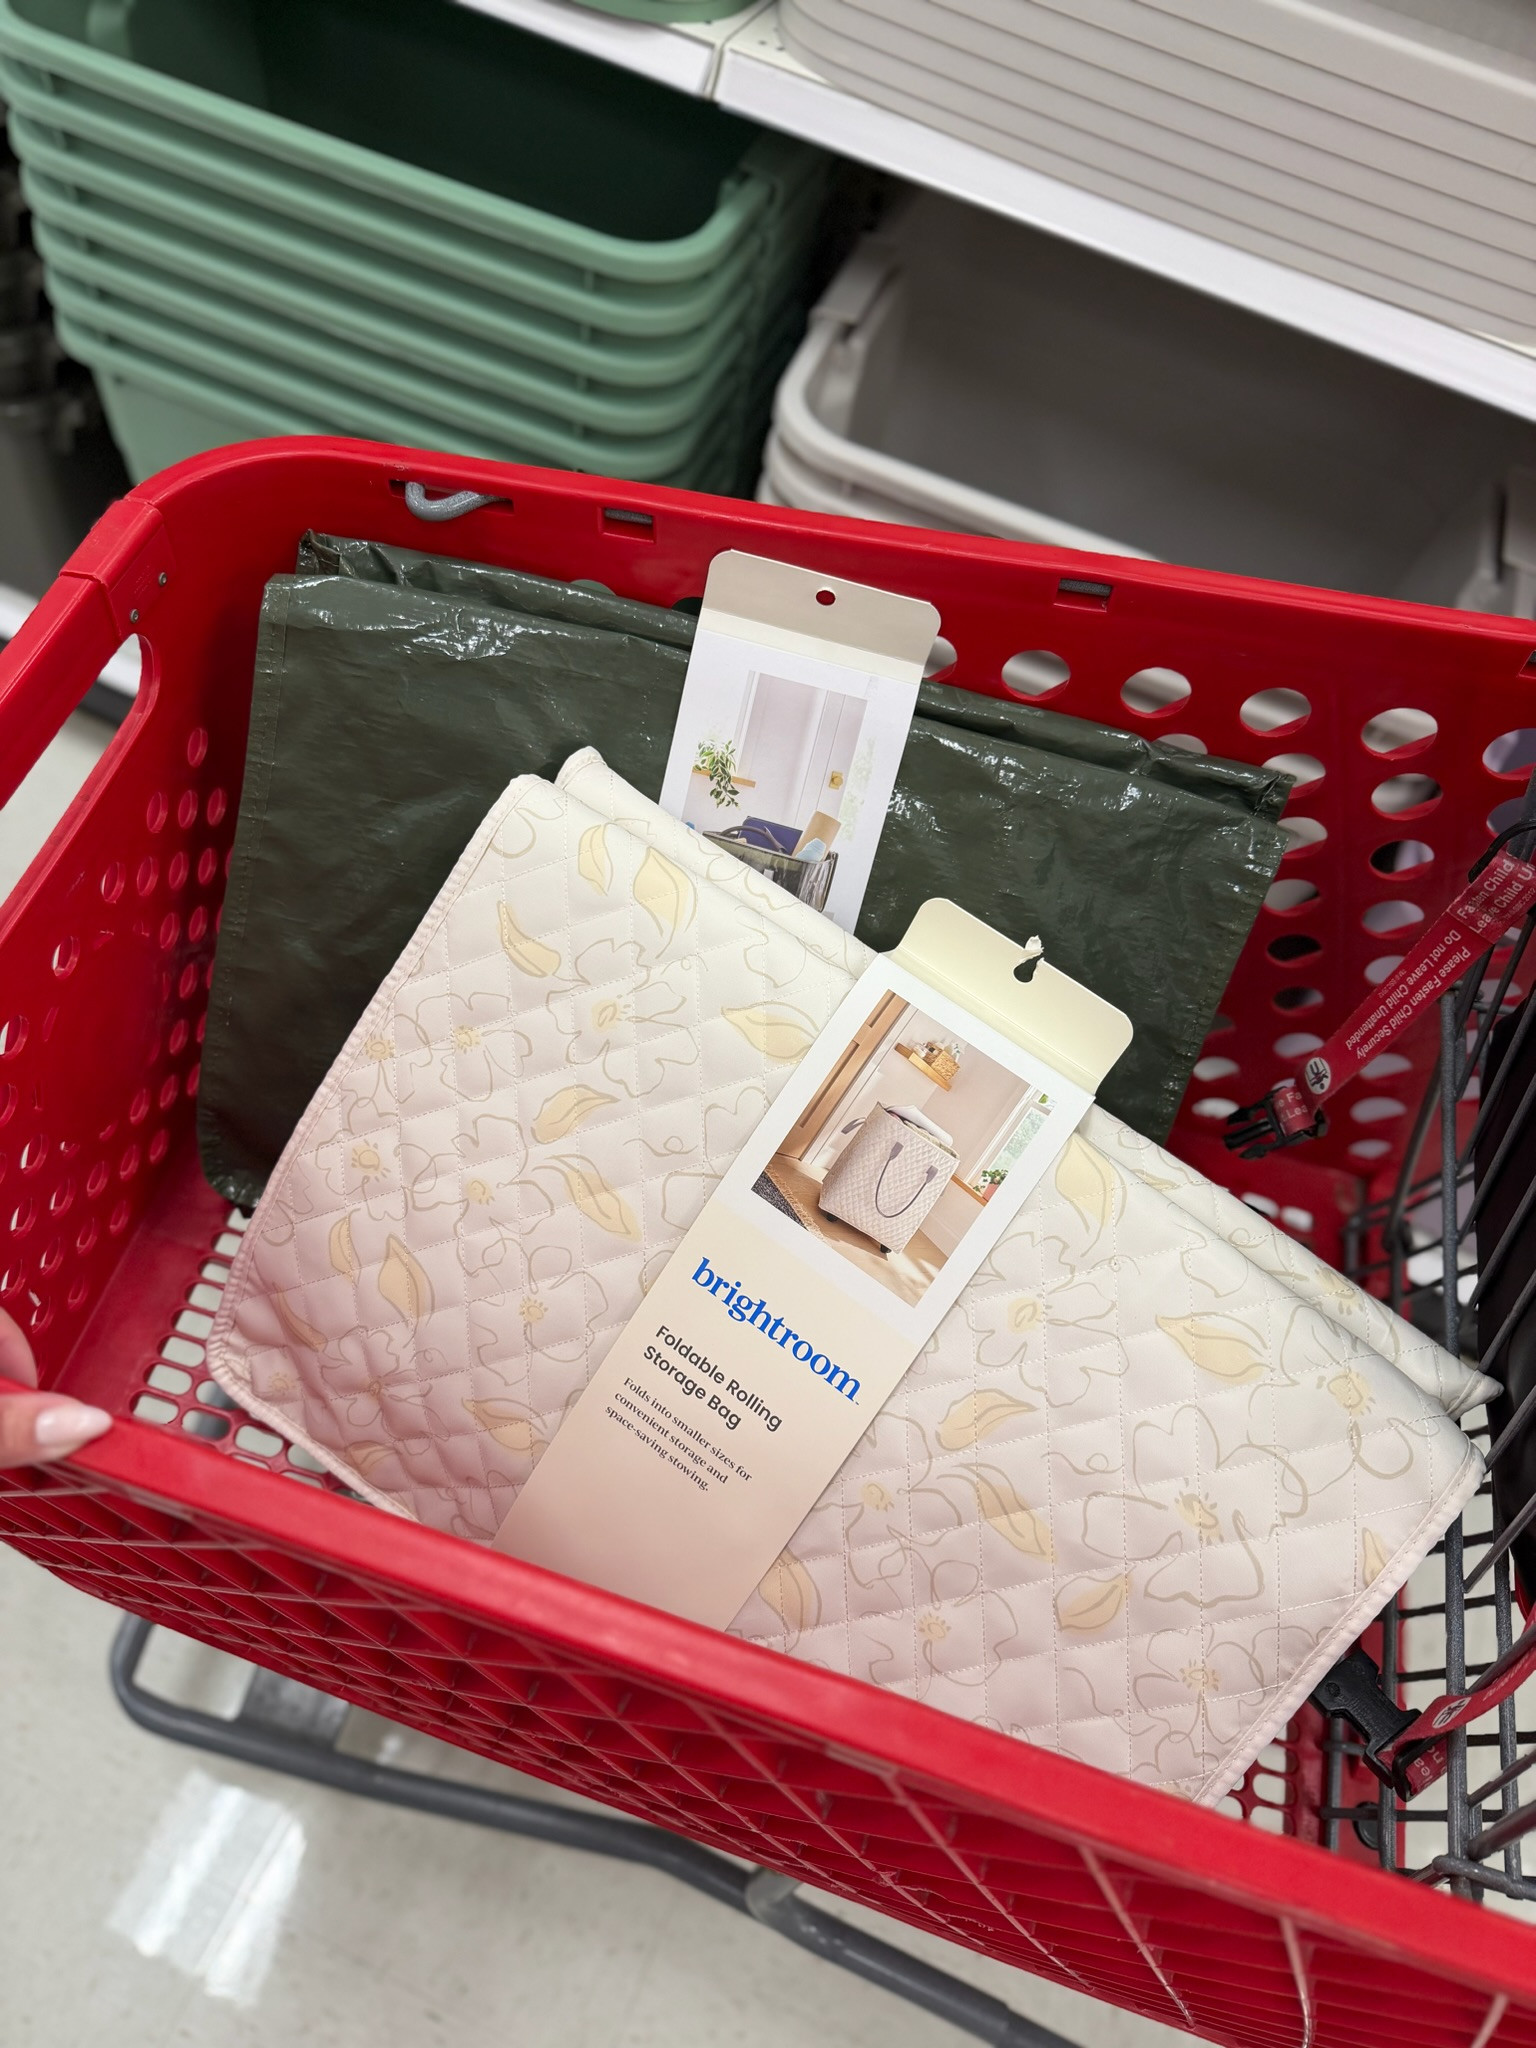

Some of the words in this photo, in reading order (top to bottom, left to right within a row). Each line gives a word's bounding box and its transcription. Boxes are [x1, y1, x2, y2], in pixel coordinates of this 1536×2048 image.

[1483, 859, 1515, 892] Child
[1494, 881, 1524, 908] Child
[1429, 944, 1446, 962] not
[1444, 929, 1462, 945] Do
[1406, 958, 1435, 985] Leave
[1438, 946, 1471, 978] Please
[1386, 984, 1409, 1009] Child
[1409, 975, 1442, 1006] Fasten
[1345, 1005, 1389, 1050] Unattended
[1389, 1005, 1412, 1026] Child
[1356, 1026, 1392, 1059] Securely
[691, 1256, 862, 1402] brightroom
[643, 1345, 706, 1399] Storage
[707, 1394, 742, 1430] Bag
[655, 1325, 725, 1384] Foldable
[725, 1379, 783, 1432] Rolling
[614, 1392, 670, 1438] convenient
[669, 1435, 707, 1467] storage
[706, 1465, 729, 1484] and
[623, 1377, 651, 1402] Folds
[650, 1398, 673, 1419] into
[671, 1416, 711, 1449] smaller
[710, 1448, 736, 1469] sizes
[735, 1465, 752, 1482] for
[605, 1406, 669, 1459] space-saving
[667, 1455, 709, 1491] stowing.
